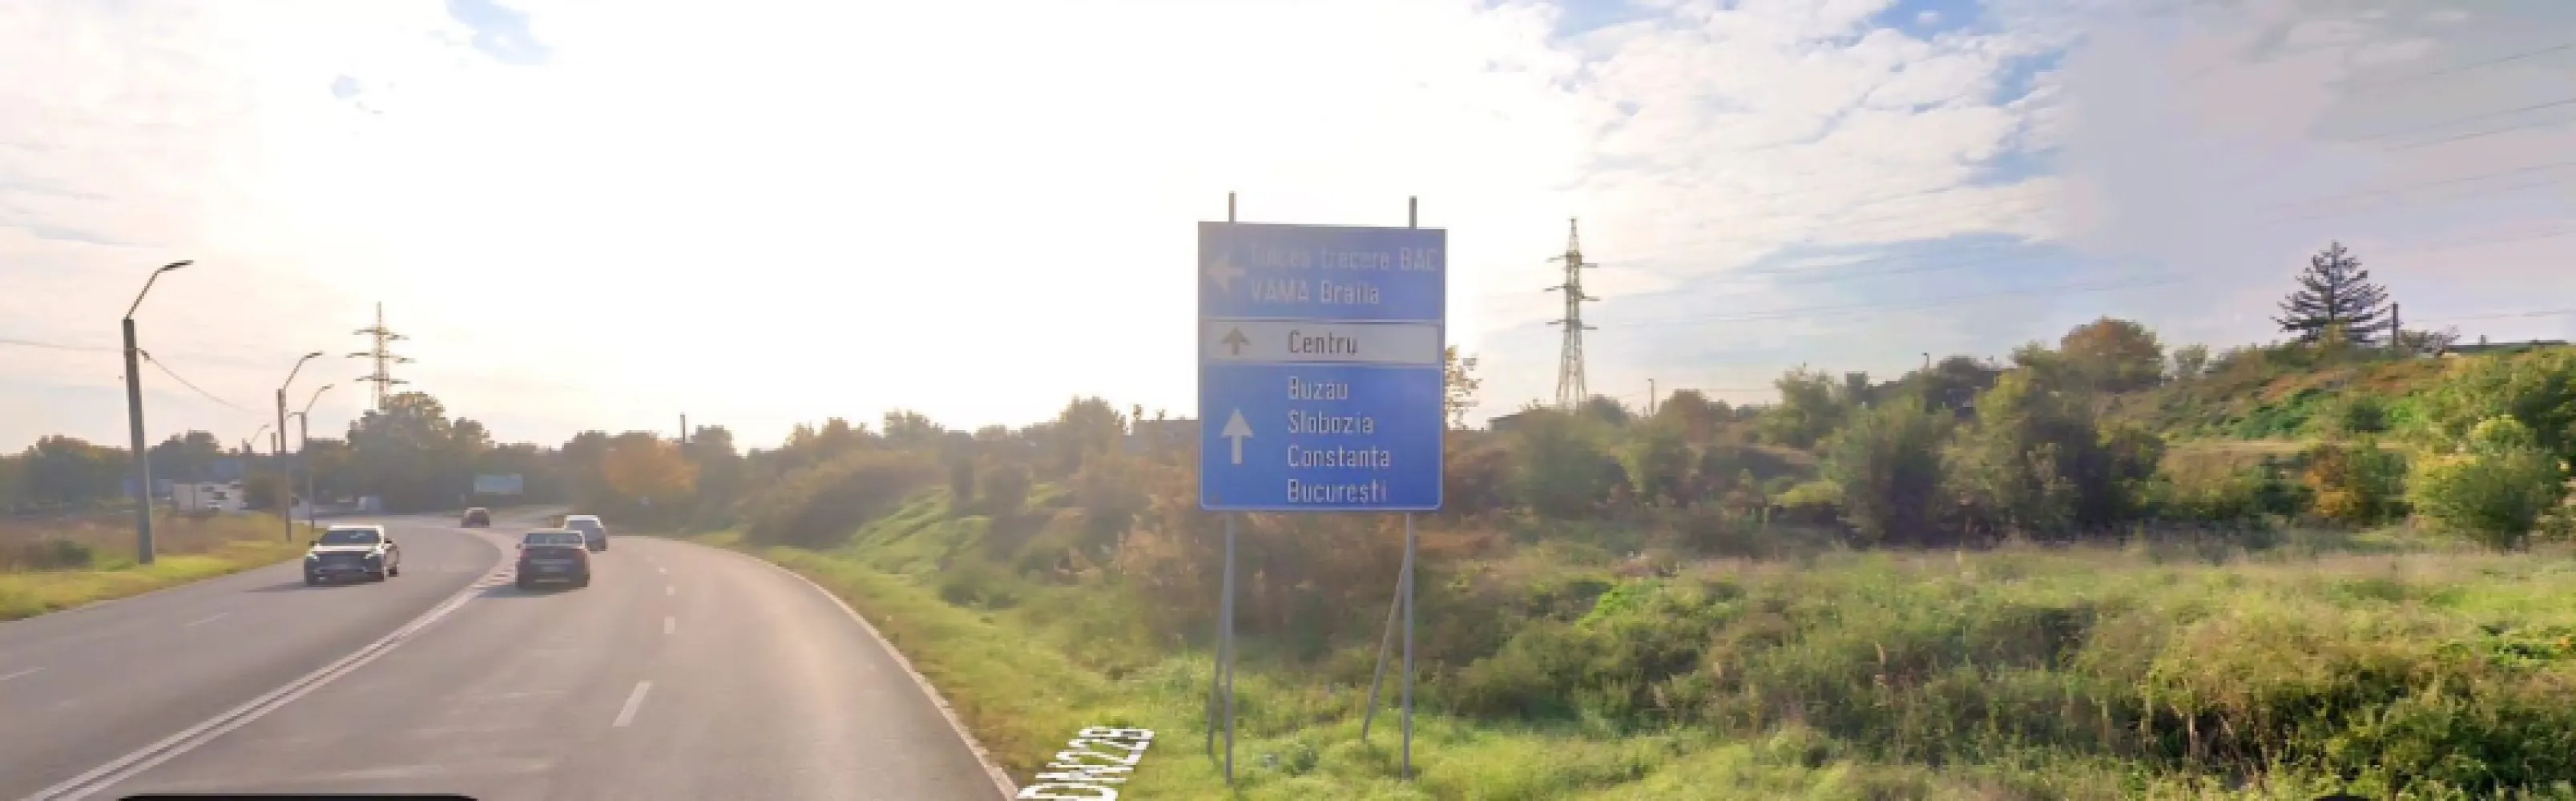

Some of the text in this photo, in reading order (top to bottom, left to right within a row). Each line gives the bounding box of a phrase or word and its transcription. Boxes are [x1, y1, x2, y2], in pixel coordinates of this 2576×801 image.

[1321, 247, 1389, 270] trecere
[1401, 248, 1438, 272] BAC
[1250, 278, 1309, 303] VAMA
[1287, 328, 1359, 355] Centru
[1287, 409, 1374, 434] Slobozia
